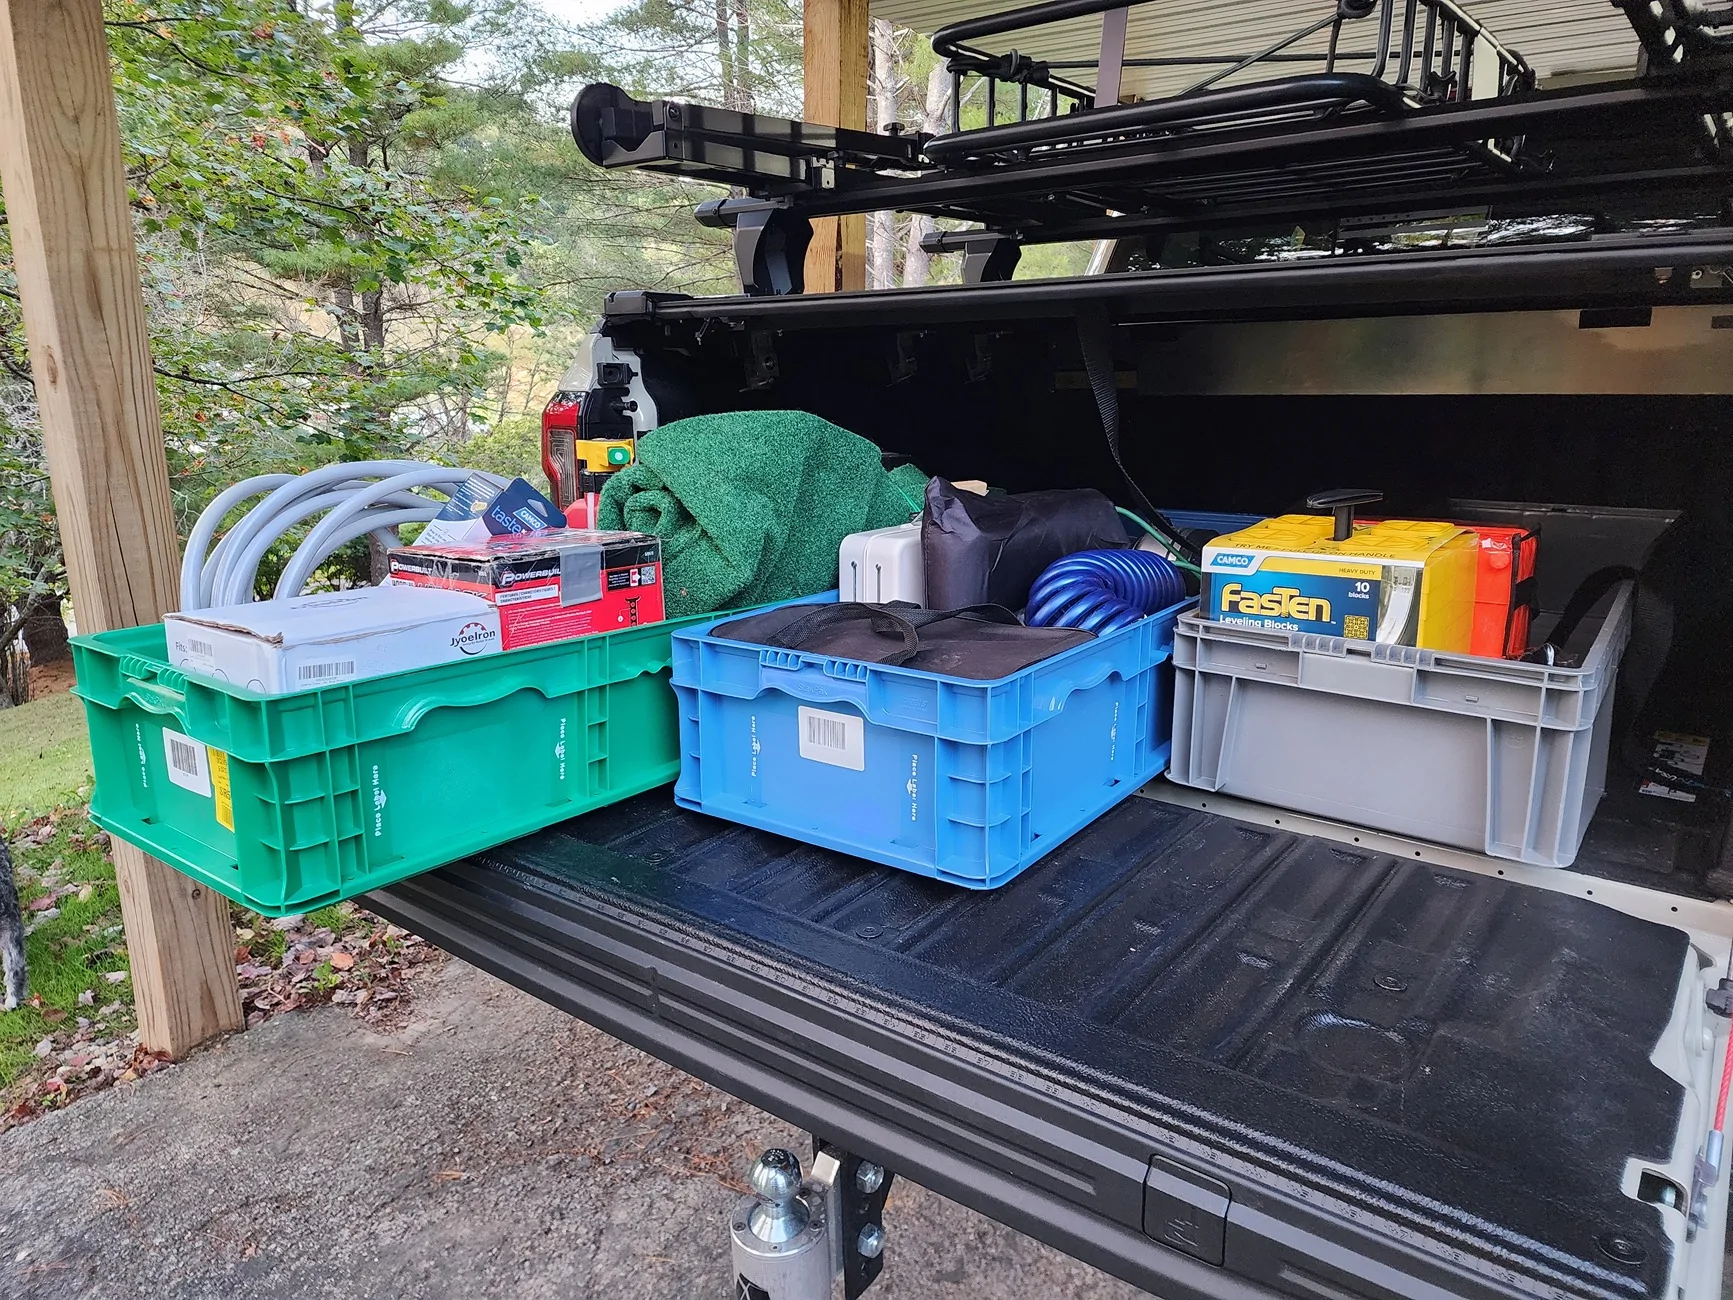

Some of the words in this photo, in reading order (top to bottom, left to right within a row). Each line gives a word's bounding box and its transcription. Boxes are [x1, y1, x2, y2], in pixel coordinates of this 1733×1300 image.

[491, 505, 521, 534] taste
[520, 510, 541, 528] CAMCO
[1217, 555, 1249, 565] CAMCO
[391, 561, 432, 575] POWERBUILT
[502, 568, 561, 585] POWERBUIL
[1354, 582, 1370, 593] 10
[1221, 582, 1332, 623] FasTen
[1348, 591, 1370, 600] blocks
[1219, 615, 1262, 628] Leveling
[1264, 620, 1299, 632] Blocks
[175, 641, 188, 653] Fits:
